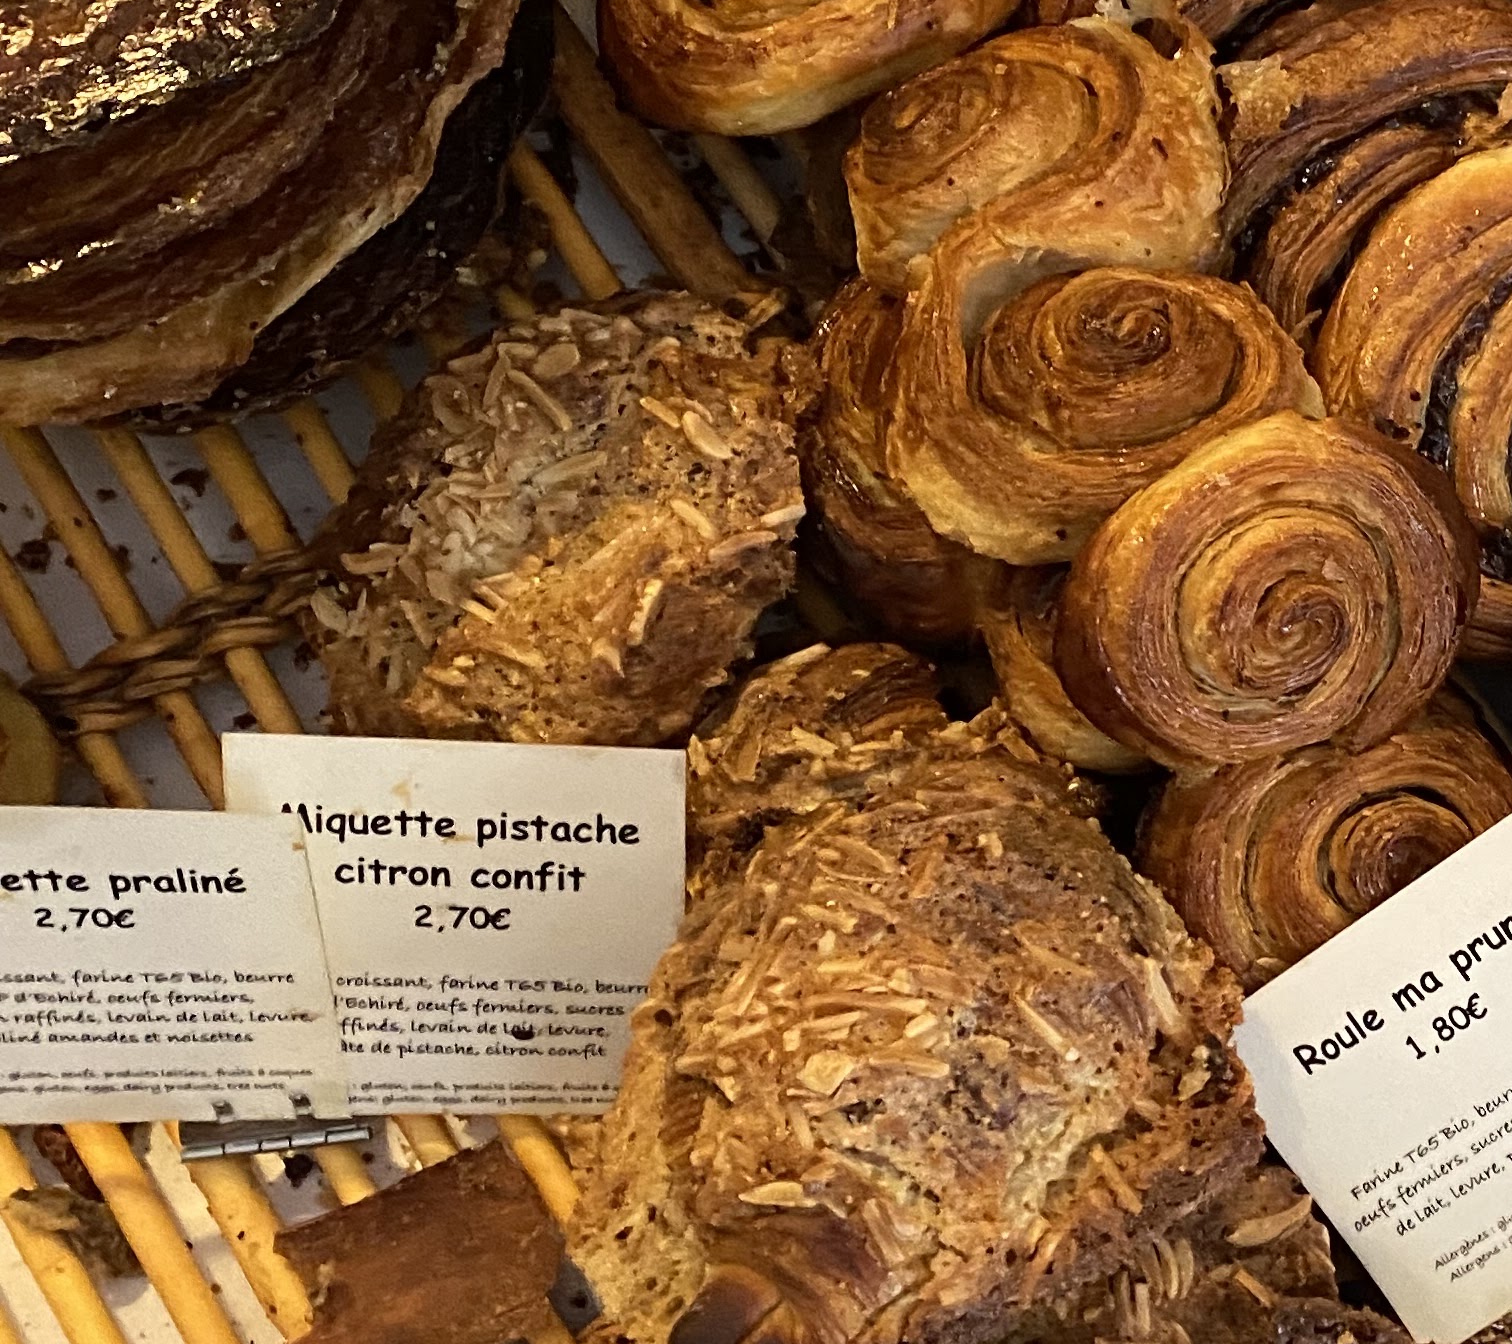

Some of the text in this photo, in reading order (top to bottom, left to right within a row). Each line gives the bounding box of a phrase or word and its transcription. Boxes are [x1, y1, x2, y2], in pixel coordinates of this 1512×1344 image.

[476, 811, 640, 849] pistache
[108, 867, 247, 900] praliné
[334, 856, 586, 892] citron confit
[33, 907, 135, 933] 2,70€
[414, 904, 511, 933] 2,70€
[72, 969, 134, 986] farine
[233, 970, 294, 983] beurre
[336, 972, 432, 990] croissant,
[438, 974, 499, 993] farine
[107, 990, 161, 1007] oeufs
[416, 997, 468, 1016] oeufs
[565, 1004, 625, 1016] sucres
[106, 1009, 171, 1023] levain
[176, 1011, 198, 1023] de
[410, 1019, 472, 1034] levain
[476, 1021, 497, 1035] de
[1292, 1009, 1385, 1075] Roule
[1391, 970, 1444, 1012] ma
[1405, 992, 1488, 1060] 1,80€
[48, 1030, 140, 1044] amandes
[144, 1032, 160, 1043] et
[166, 1031, 254, 1043] noisettes
[370, 1039, 606, 1060] de pistache, citron confit
[1350, 1161, 1404, 1200] Farine
[1405, 1134, 1439, 1164] T65
[1438, 1118, 1475, 1140] Bio,
[1354, 1198, 1396, 1232] oeufs
[1397, 1154, 1468, 1205] fermiers,
[1396, 1218, 1416, 1236] de
[1413, 1197, 1451, 1222] lait,
[1449, 1162, 1505, 1199] levure,
